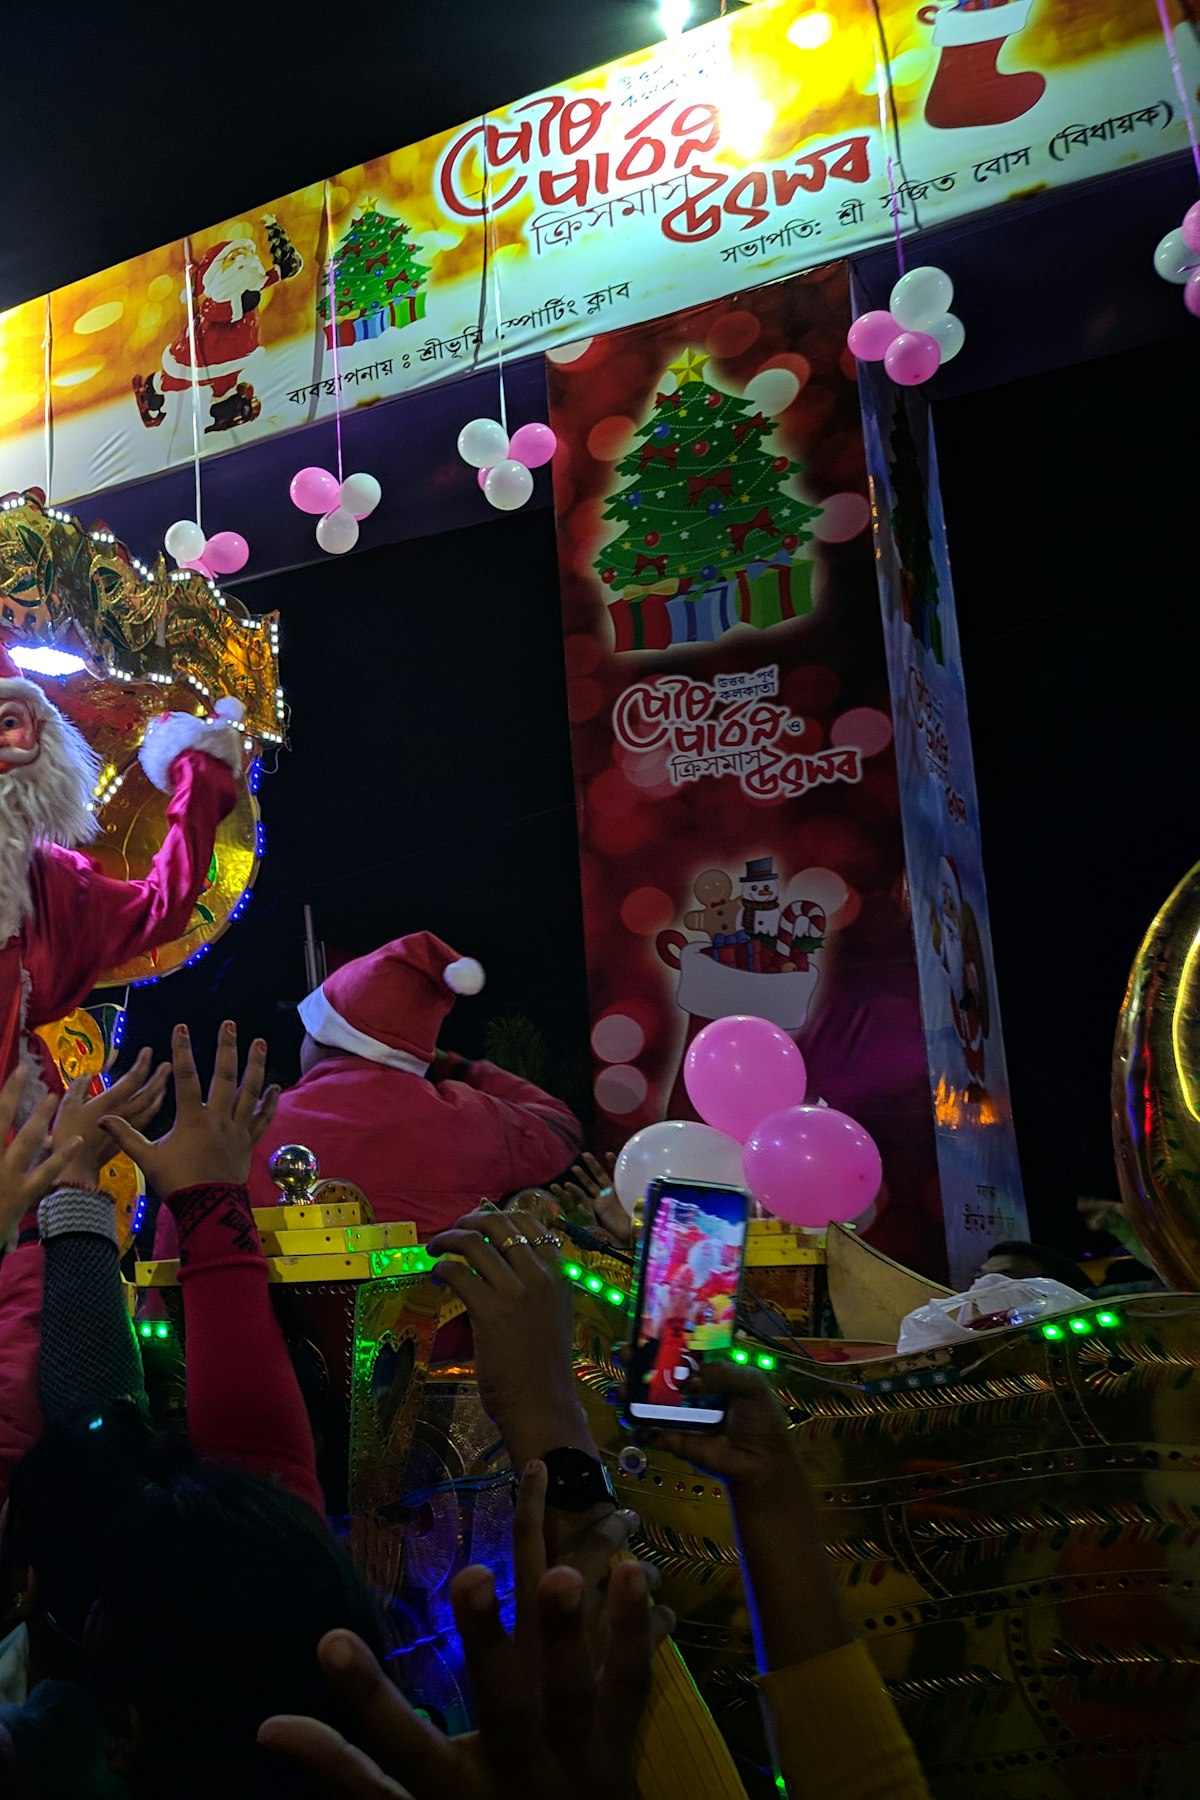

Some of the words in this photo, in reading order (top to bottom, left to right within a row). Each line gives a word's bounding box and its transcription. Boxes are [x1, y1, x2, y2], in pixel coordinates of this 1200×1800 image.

[530, 172, 691, 255] ক্রিসমাস
[661, 135, 871, 243] উৎসব
[720, 218, 822, 263] সভাপতি:
[836, 198, 866, 226] শ্রী
[878, 172, 957, 217] সুজিত
[972, 146, 1032, 182] বোস
[1048, 100, 1174, 161] (বিধায়ক)
[416, 325, 484, 362] শ্রীভূমি
[495, 294, 580, 340] স্পোর্টিং
[583, 281, 633, 315] ক্লাব
[717, 675, 746, 688] উত্তর
[756, 667, 775, 683] পূর্ব
[718, 682, 776, 701] কলকাতা
[788, 720, 801, 733] ও
[670, 749, 762, 782] ক্রিসমাস
[744, 747, 859, 795] উৎসব
